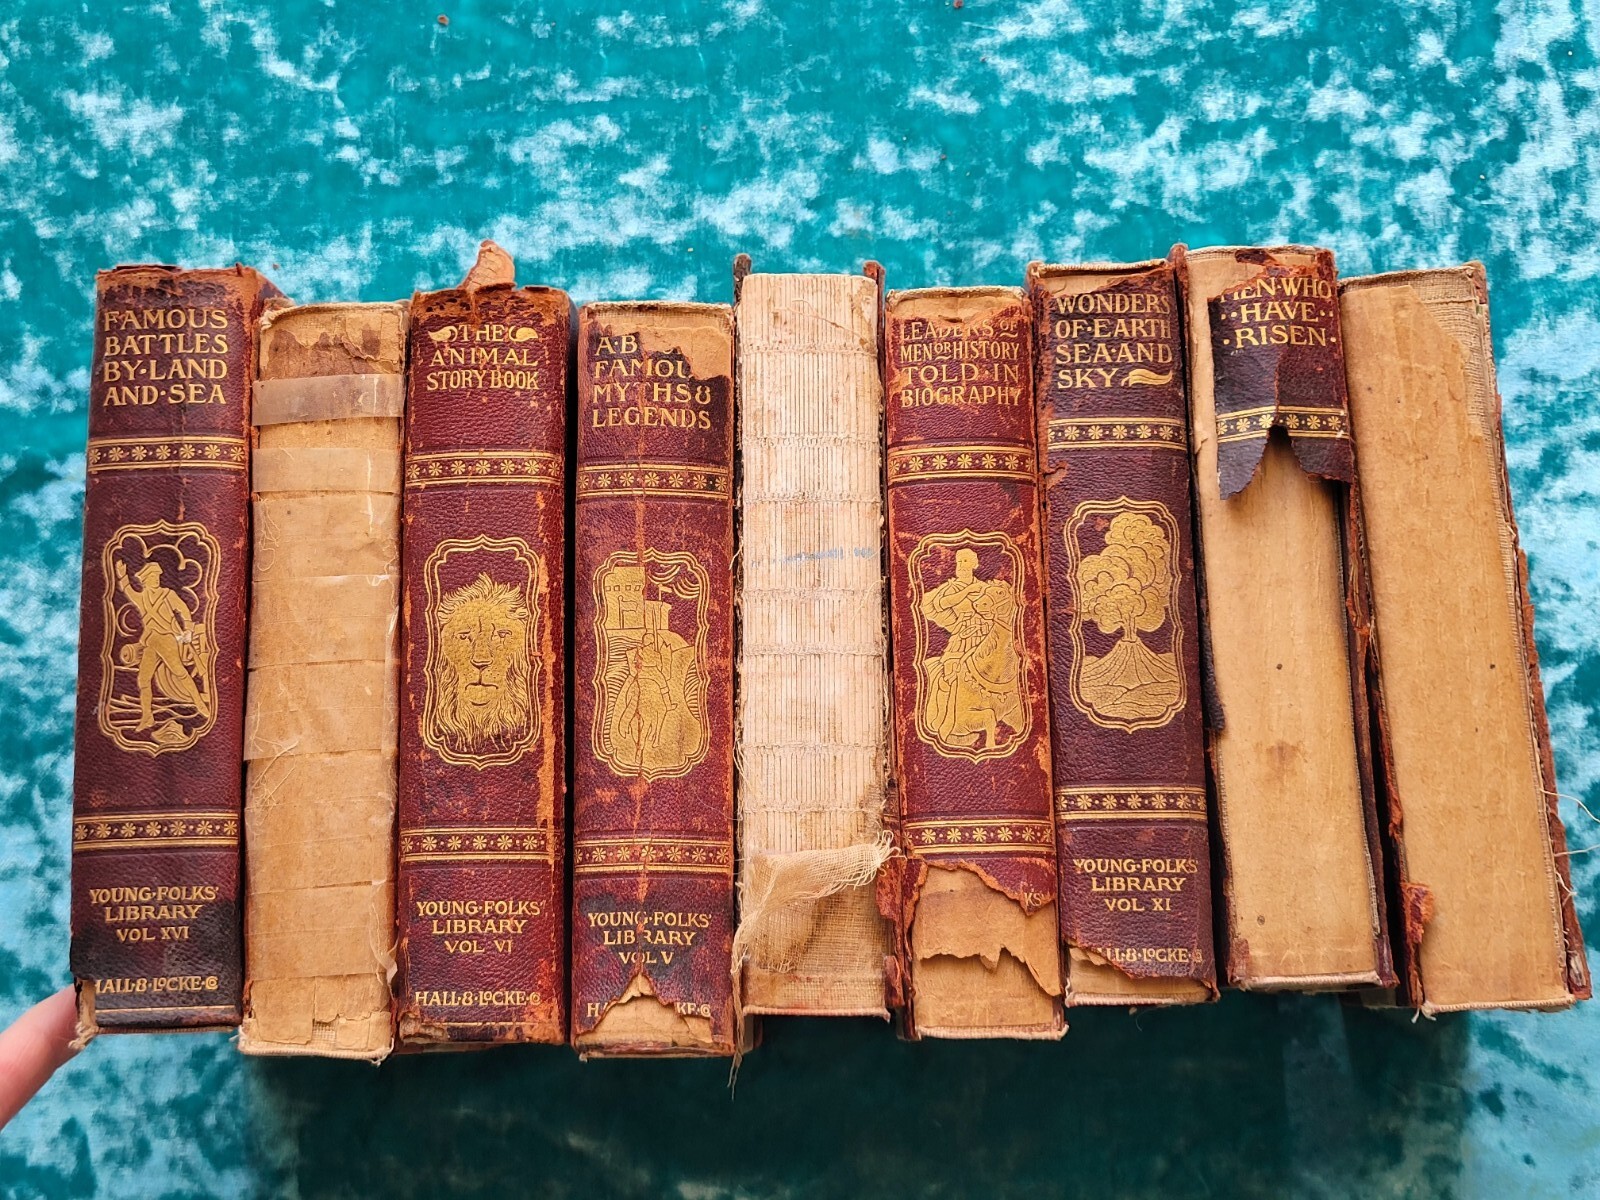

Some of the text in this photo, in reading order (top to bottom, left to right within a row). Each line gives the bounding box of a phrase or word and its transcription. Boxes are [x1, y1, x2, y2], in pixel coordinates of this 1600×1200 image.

[1280, 277, 1332, 299] WHO
[1055, 293, 1171, 315] WONDERS
[104, 308, 229, 331] FAMOUS
[1055, 318, 1172, 339] OF EARTH
[459, 324, 504, 342] THE
[104, 333, 229, 357] BATTLES
[900, 343, 933, 363] MEN
[952, 340, 1020, 360] HISTORY
[1055, 342, 1173, 364] SEA AND
[429, 348, 538, 367] ANIMAL
[103, 358, 228, 382] BY LAND
[594, 358, 693, 379] FAMOU
[902, 363, 1020, 385] TOLD IN
[1057, 367, 1120, 389] SKY
[103, 383, 227, 406] AND SEA
[592, 381, 692, 404] MYHS
[901, 385, 1022, 408] BIOGRAPHY
[592, 406, 711, 429] LEGENDS
[1072, 858, 1137, 874] YOUNG
[1091, 877, 1187, 892] LIBRARY
[89, 886, 153, 905] YOUNG
[1104, 898, 1172, 912] VOL XI
[104, 904, 203, 923] LIBRARY
[416, 900, 478, 916] YOUNG
[116, 925, 190, 942] VOL XVI
[432, 919, 528, 935] LIBRARY
[444, 939, 513, 954] VOL VI
[603, 930, 698, 946] LIBRARY
[618, 951, 675, 965] VOL V
[415, 991, 459, 1006] HALL
